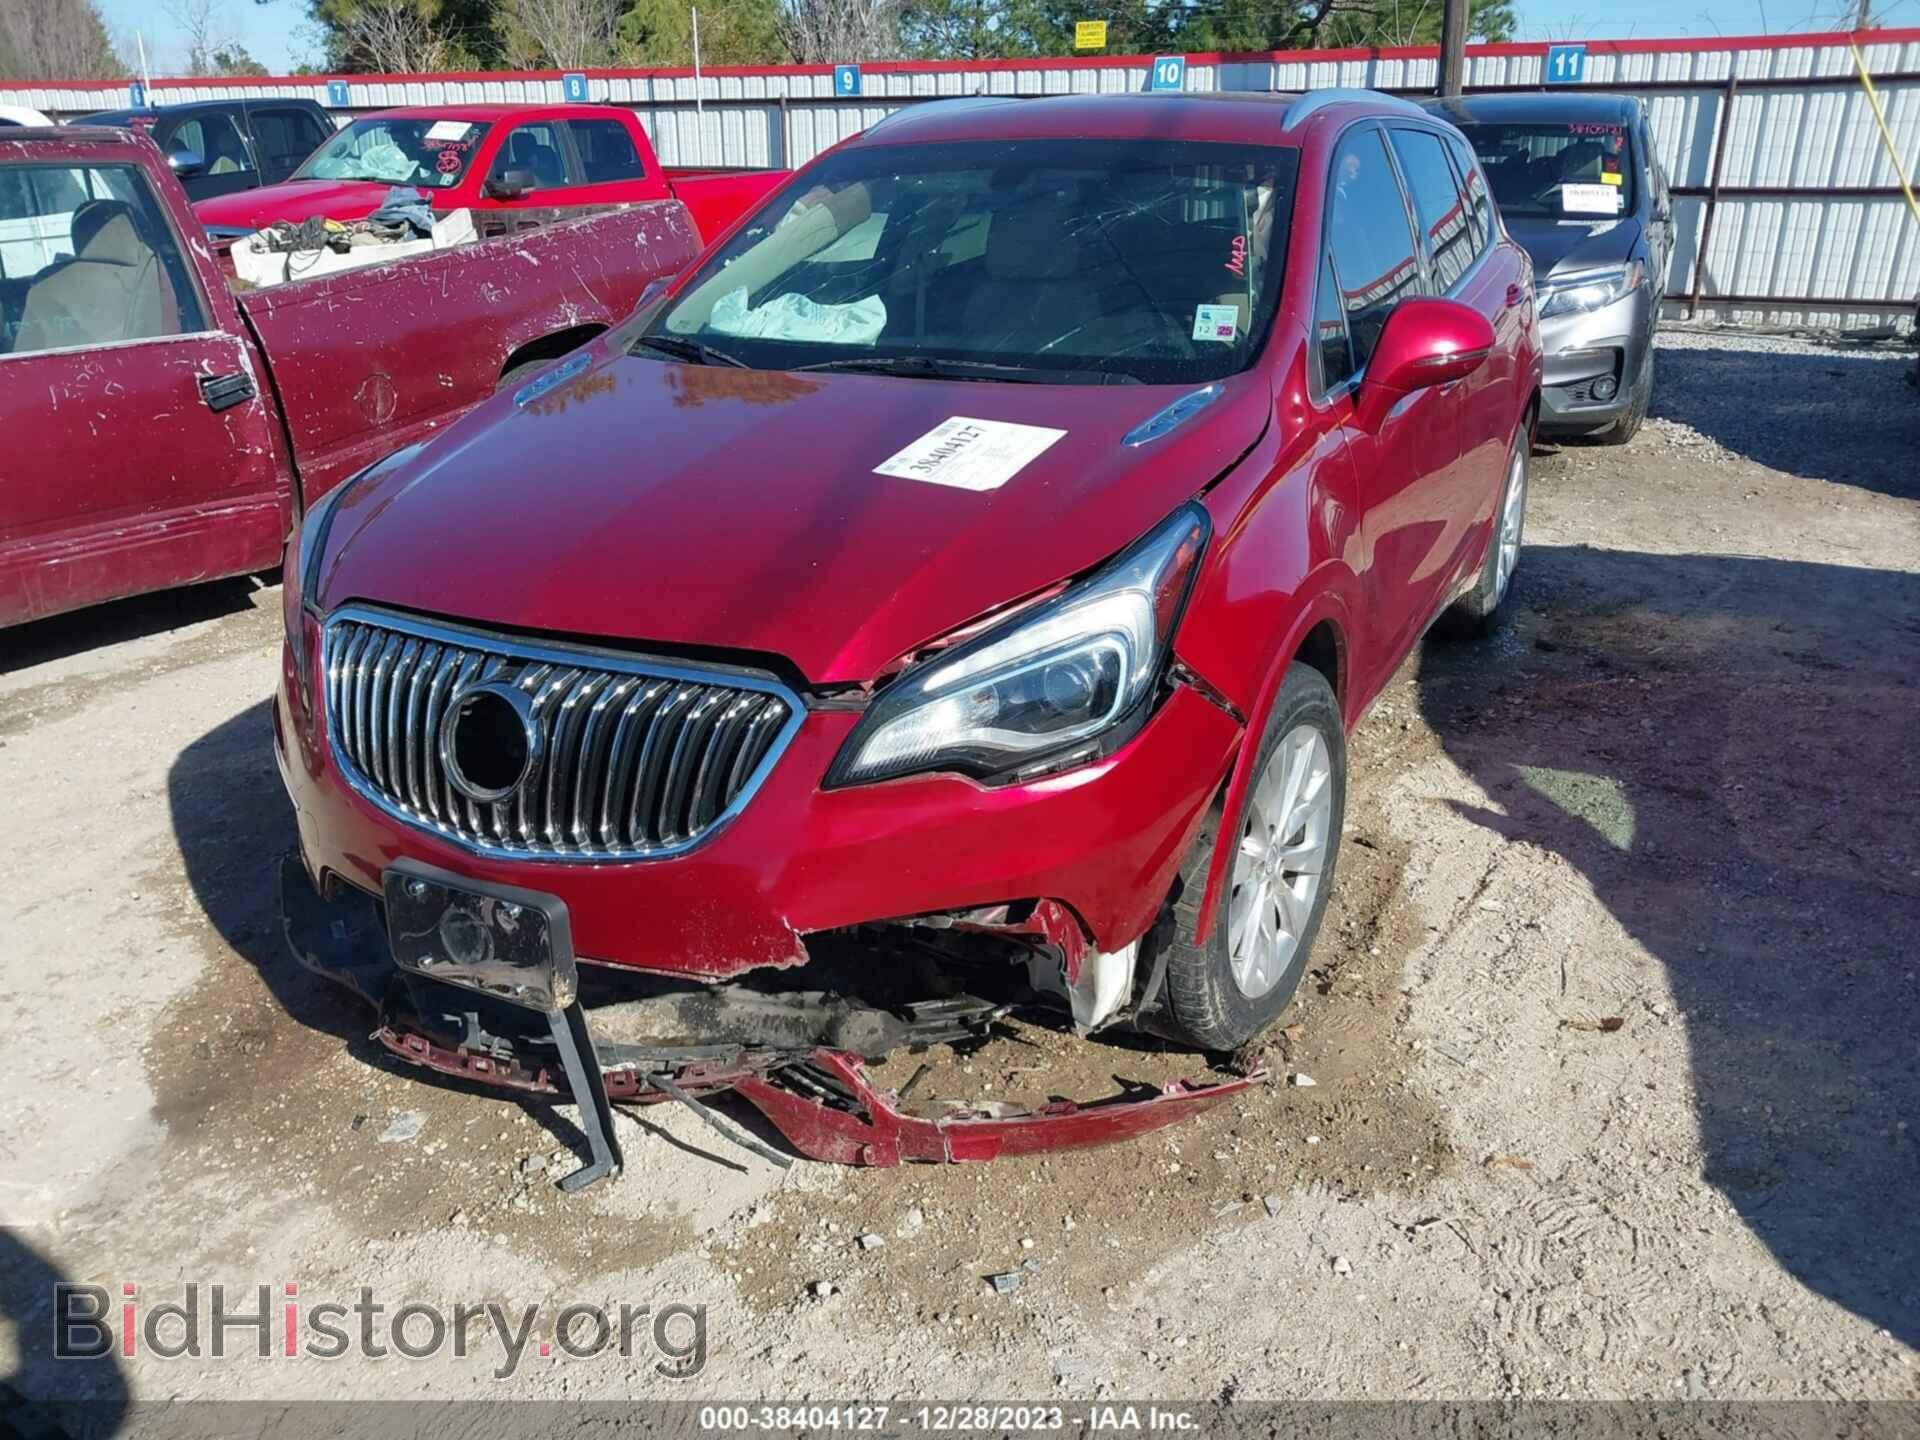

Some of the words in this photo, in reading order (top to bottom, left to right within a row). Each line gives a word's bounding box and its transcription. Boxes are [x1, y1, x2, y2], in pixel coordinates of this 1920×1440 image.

[1158, 63, 1179, 83] 10
[1556, 53, 1578, 76] 11
[571, 79, 580, 97] 8
[843, 71, 853, 90] 9
[333, 85, 342, 101] 7
[910, 425, 987, 473] 38404127
